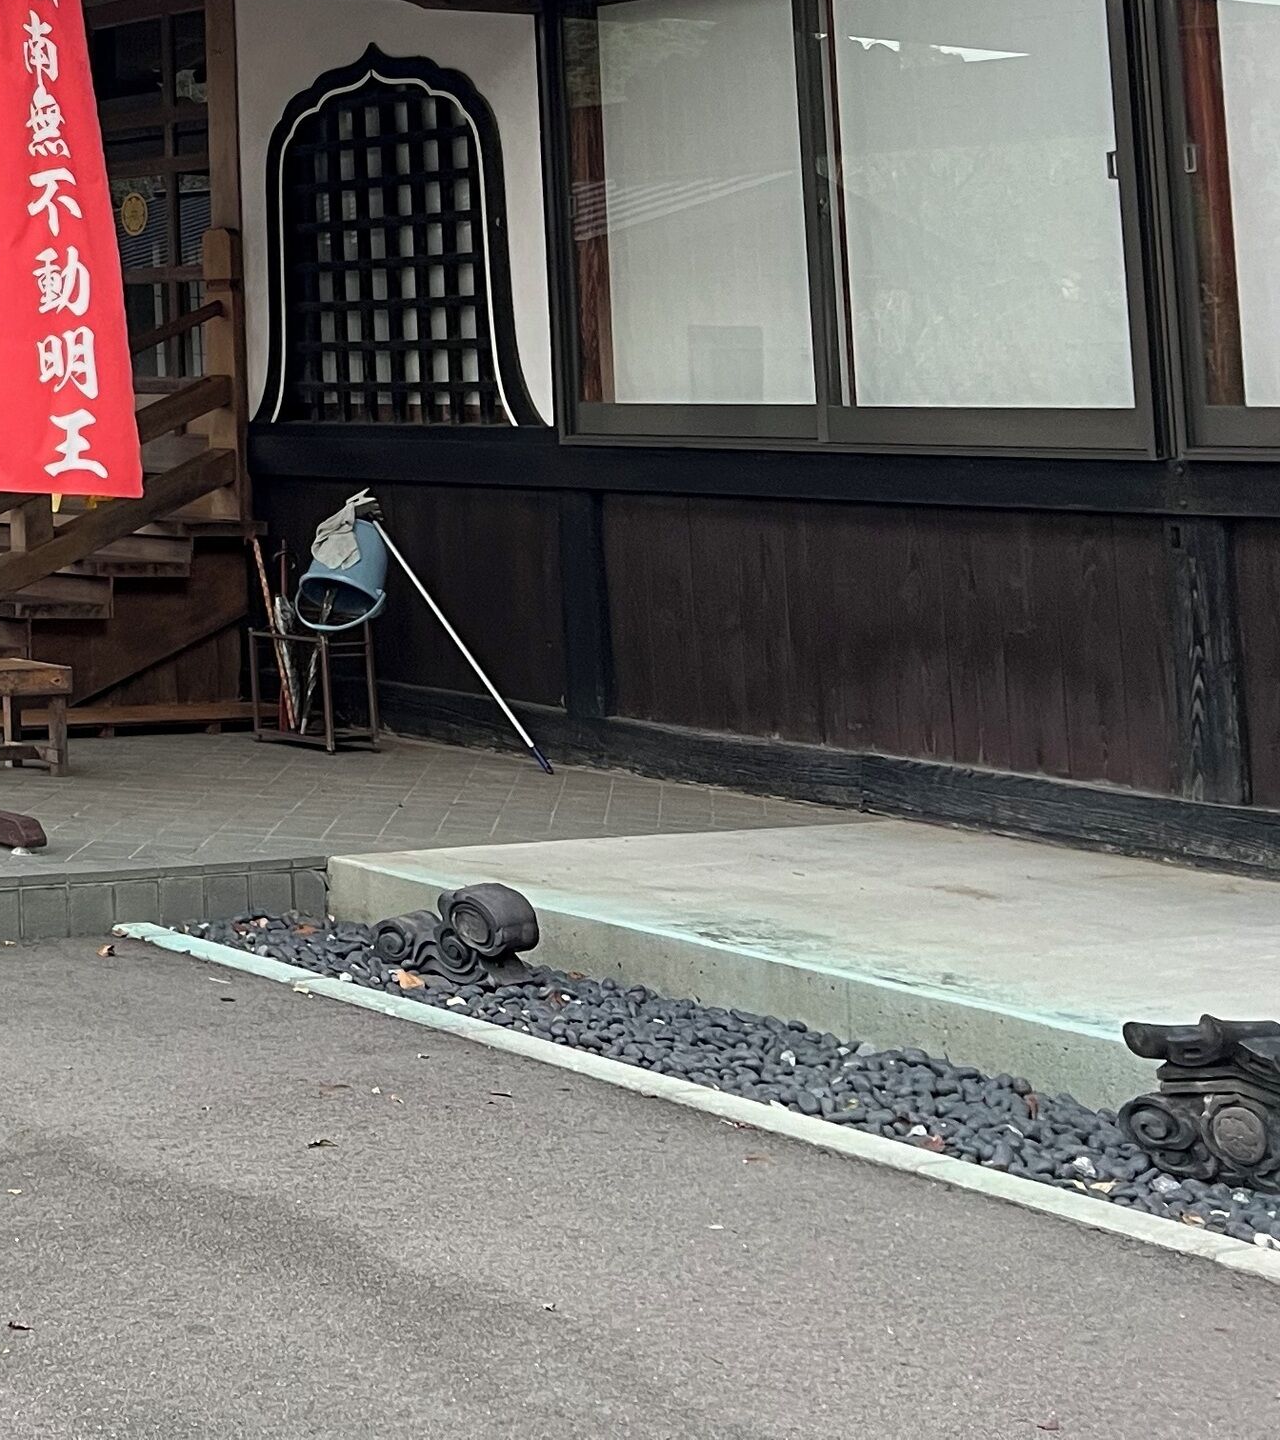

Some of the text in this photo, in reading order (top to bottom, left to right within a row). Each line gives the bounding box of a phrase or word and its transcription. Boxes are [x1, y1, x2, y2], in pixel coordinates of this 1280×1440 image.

[23, 10, 109, 481] 南無不動明王
